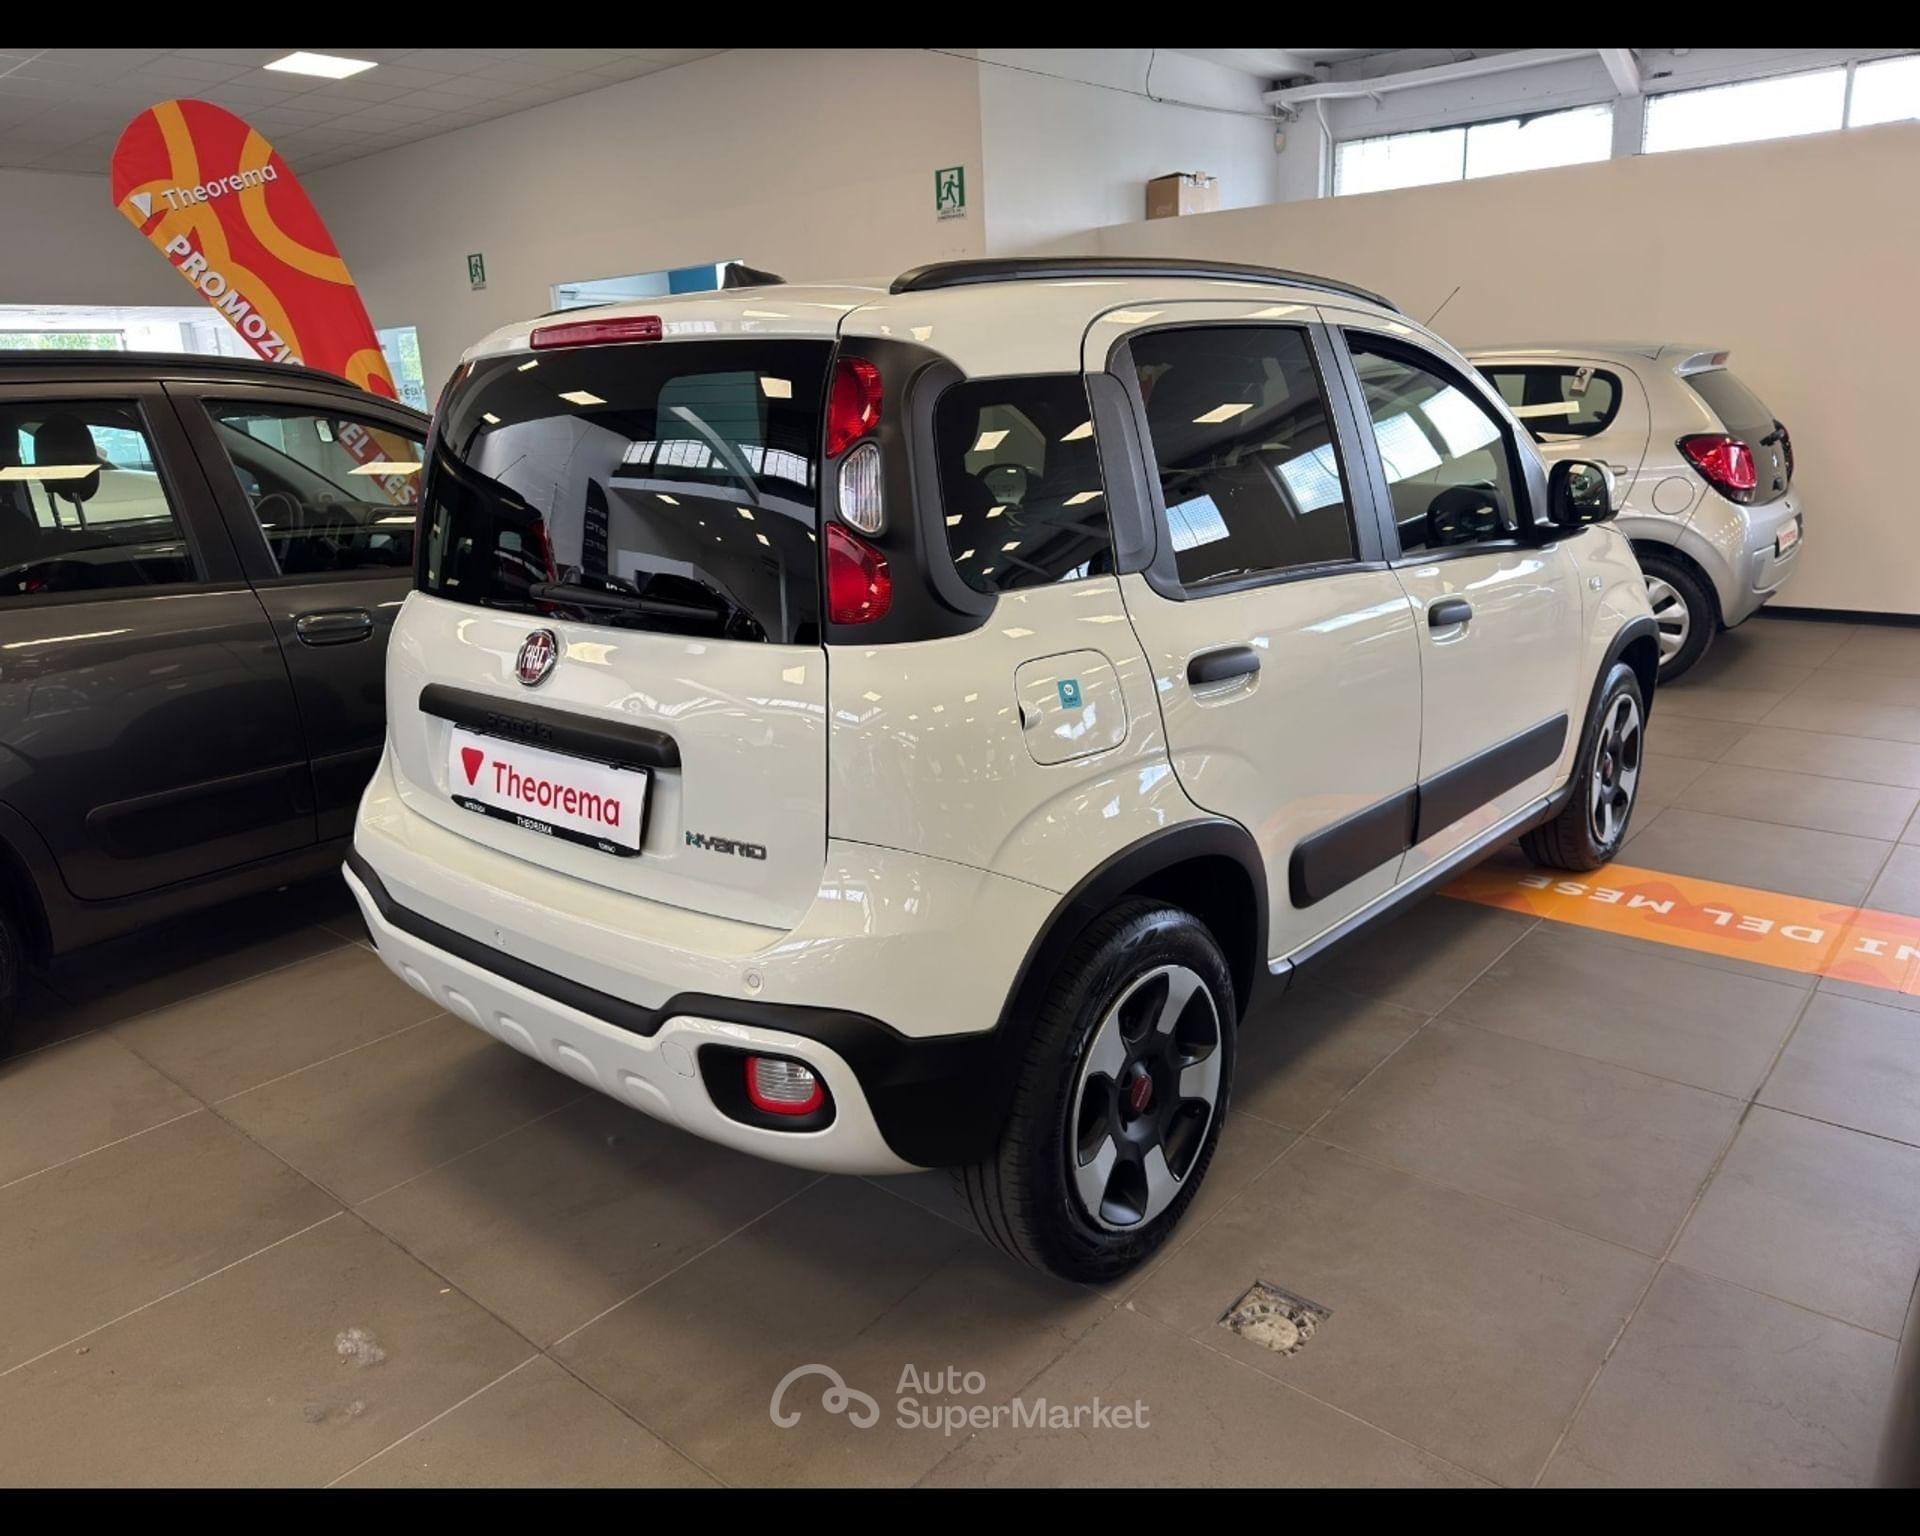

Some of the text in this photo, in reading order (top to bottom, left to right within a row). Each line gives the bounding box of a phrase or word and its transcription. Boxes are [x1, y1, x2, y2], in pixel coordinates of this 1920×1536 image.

[161, 163, 278, 212] Theorema
[492, 761, 621, 827] Theorema
[516, 815, 554, 836] THEOREMA
[685, 830, 767, 861] HYBRID
[1518, 874, 1676, 914] MESE
[1703, 907, 1825, 944] DEL
